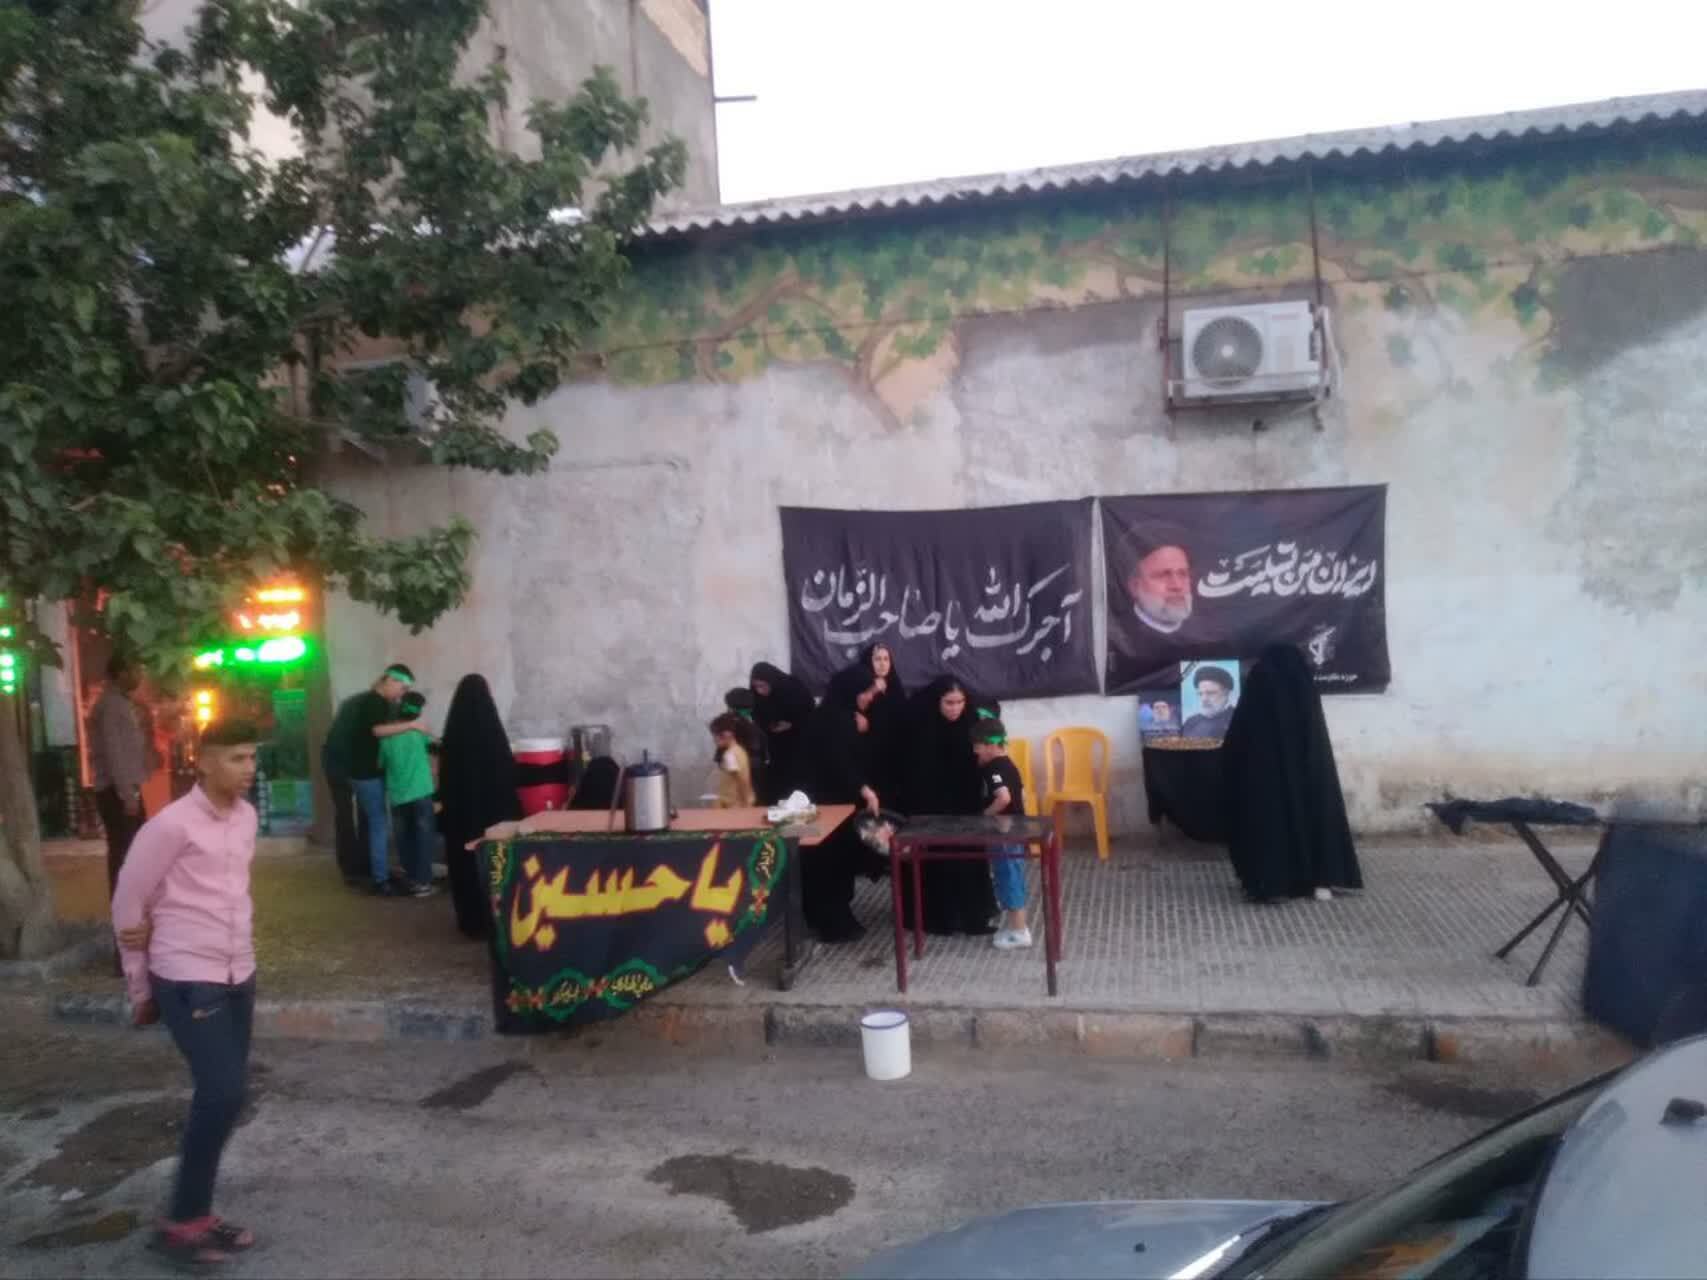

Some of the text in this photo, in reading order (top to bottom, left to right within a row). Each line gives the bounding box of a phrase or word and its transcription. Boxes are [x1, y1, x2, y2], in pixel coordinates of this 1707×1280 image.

[801, 563, 887, 626] الزمان
[973, 565, 1022, 623] الله
[1197, 541, 1377, 598] ایران من تسلیت
[823, 583, 943, 659] صاحب
[943, 599, 962, 661] یا
[510, 854, 691, 948] حسین
[690, 842, 743, 948] یا
